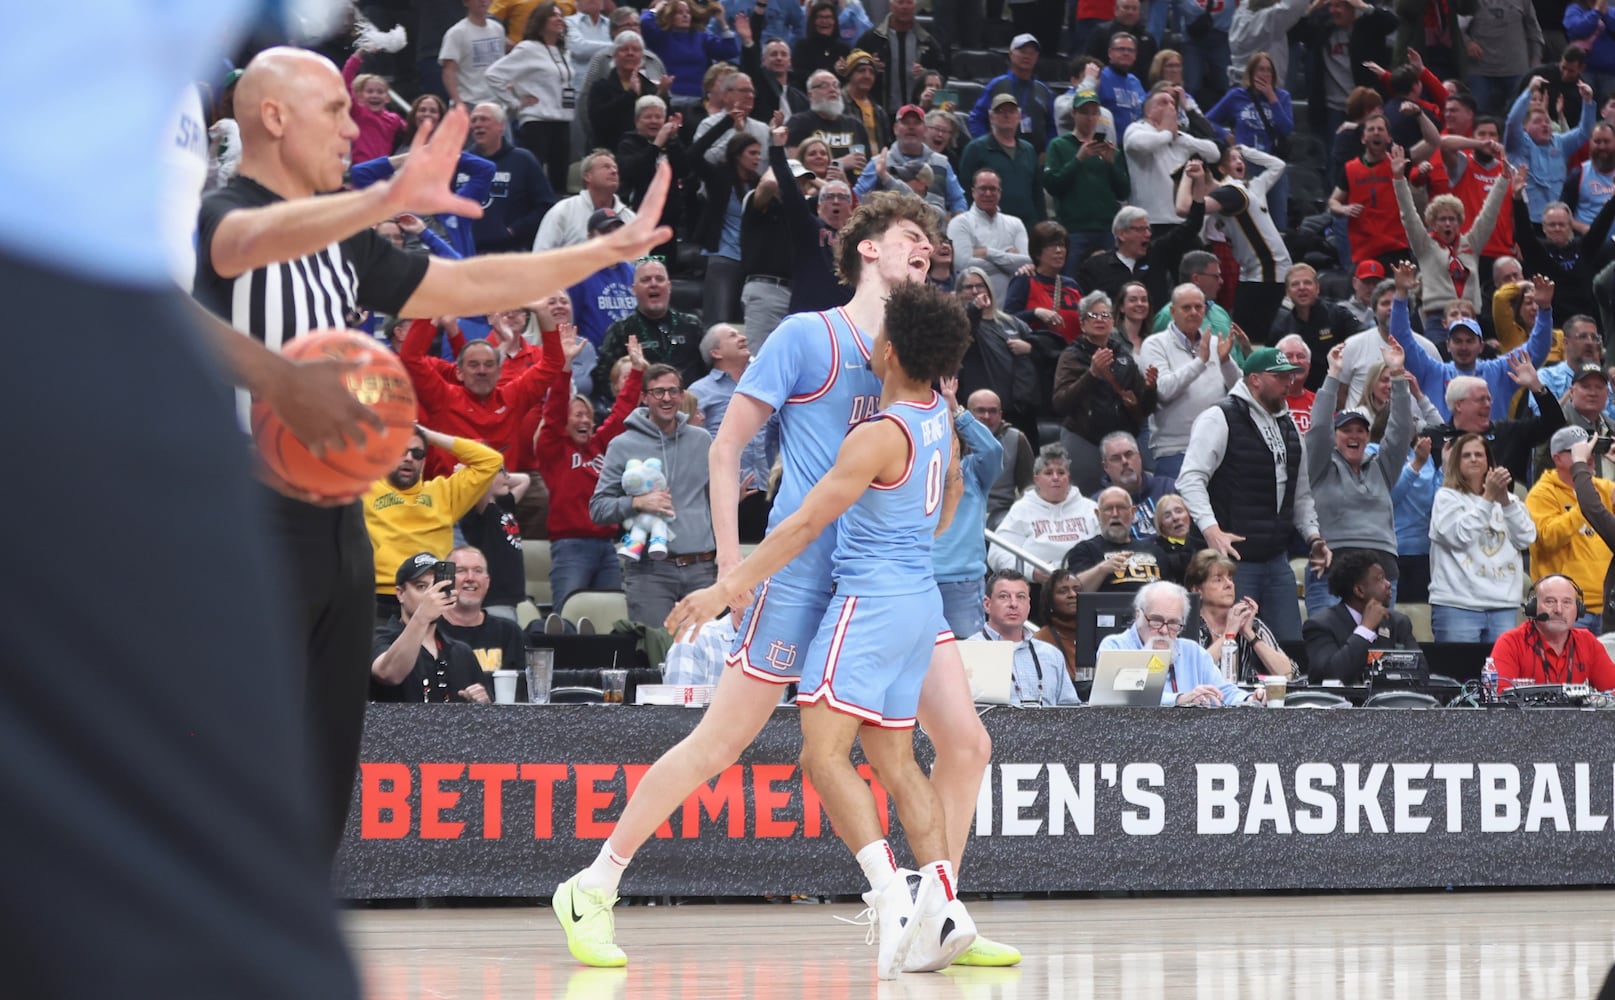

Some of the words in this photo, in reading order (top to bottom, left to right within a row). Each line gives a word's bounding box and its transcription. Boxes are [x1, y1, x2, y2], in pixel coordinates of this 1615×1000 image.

[924, 447, 943, 517] 0
[360, 763, 889, 839] BETTEME
[1194, 762, 1615, 835] BASKETBAL
